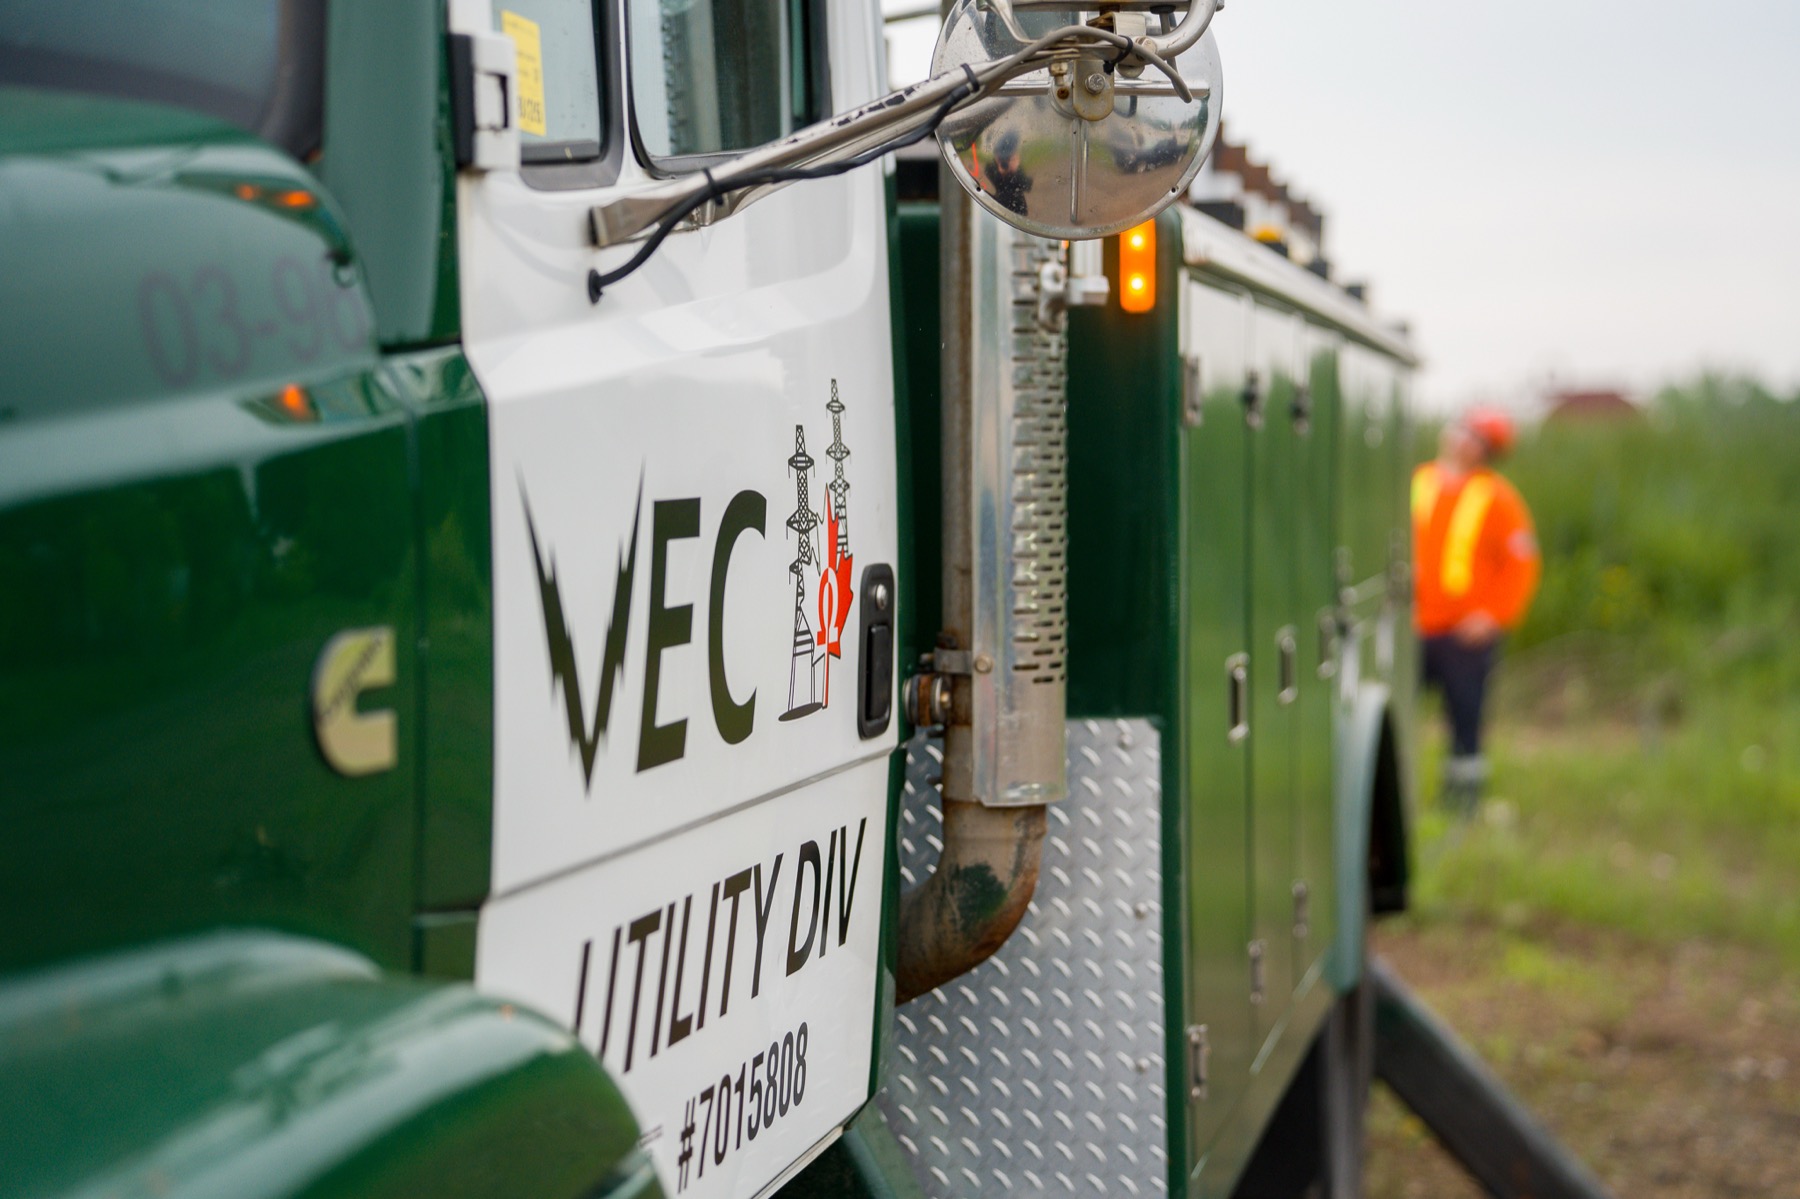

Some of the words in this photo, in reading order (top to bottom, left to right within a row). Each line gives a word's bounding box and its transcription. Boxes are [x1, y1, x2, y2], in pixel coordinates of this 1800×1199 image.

[515, 454, 768, 798] VEC
[574, 852, 785, 1075] UTILITY
[785, 816, 868, 978] DIV
[677, 1021, 809, 1195] #7015808
